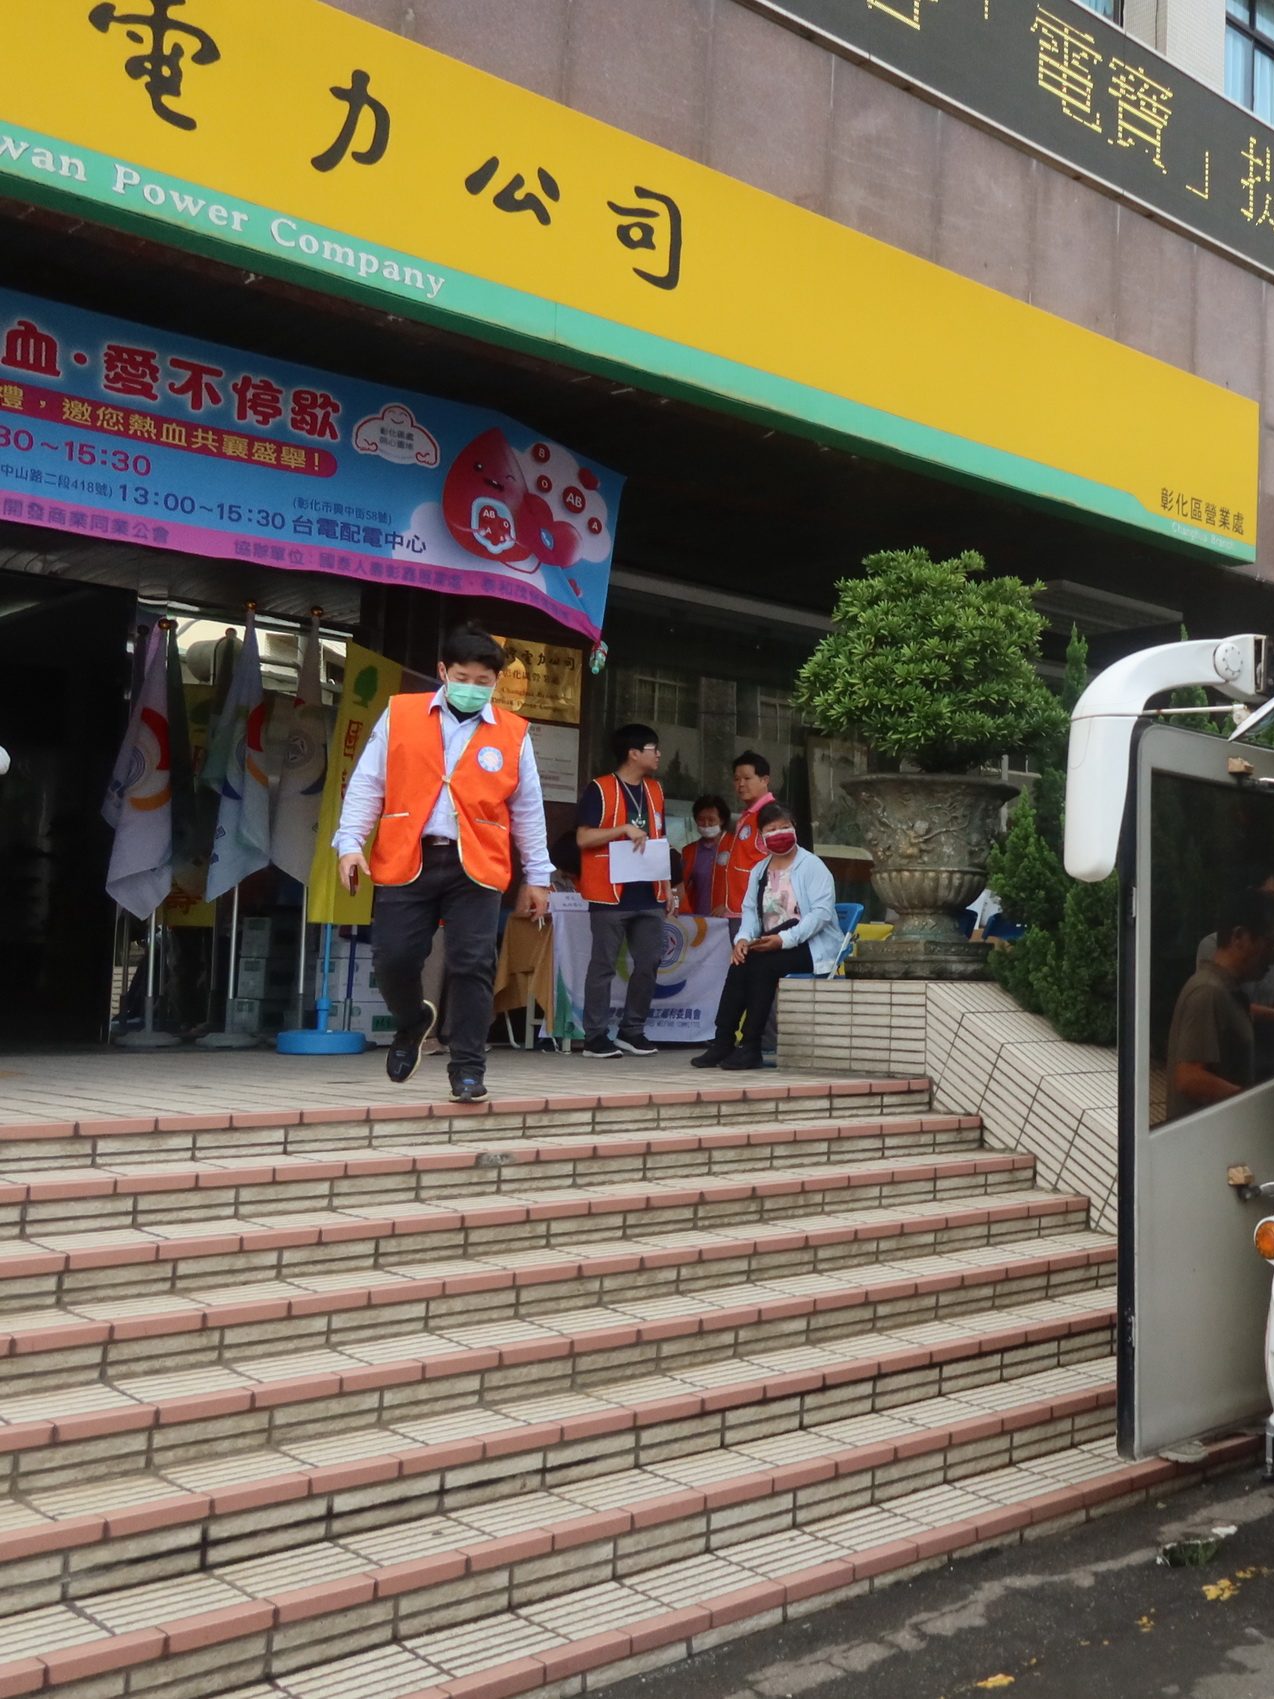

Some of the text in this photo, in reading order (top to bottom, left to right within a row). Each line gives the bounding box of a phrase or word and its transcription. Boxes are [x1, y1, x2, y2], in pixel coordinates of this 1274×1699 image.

[89, 0, 683, 291] 電力公司
[111, 163, 249, 232] Power
[270, 218, 446, 298] Company
[538, 448, 545, 458] B
[566, 492, 583, 508] AB
[1160, 487, 1245, 536] 彰化區營業處
[483, 509, 496, 519] AB
[592, 522, 599, 531] A
[292, 515, 427, 554] 台電配電中心
